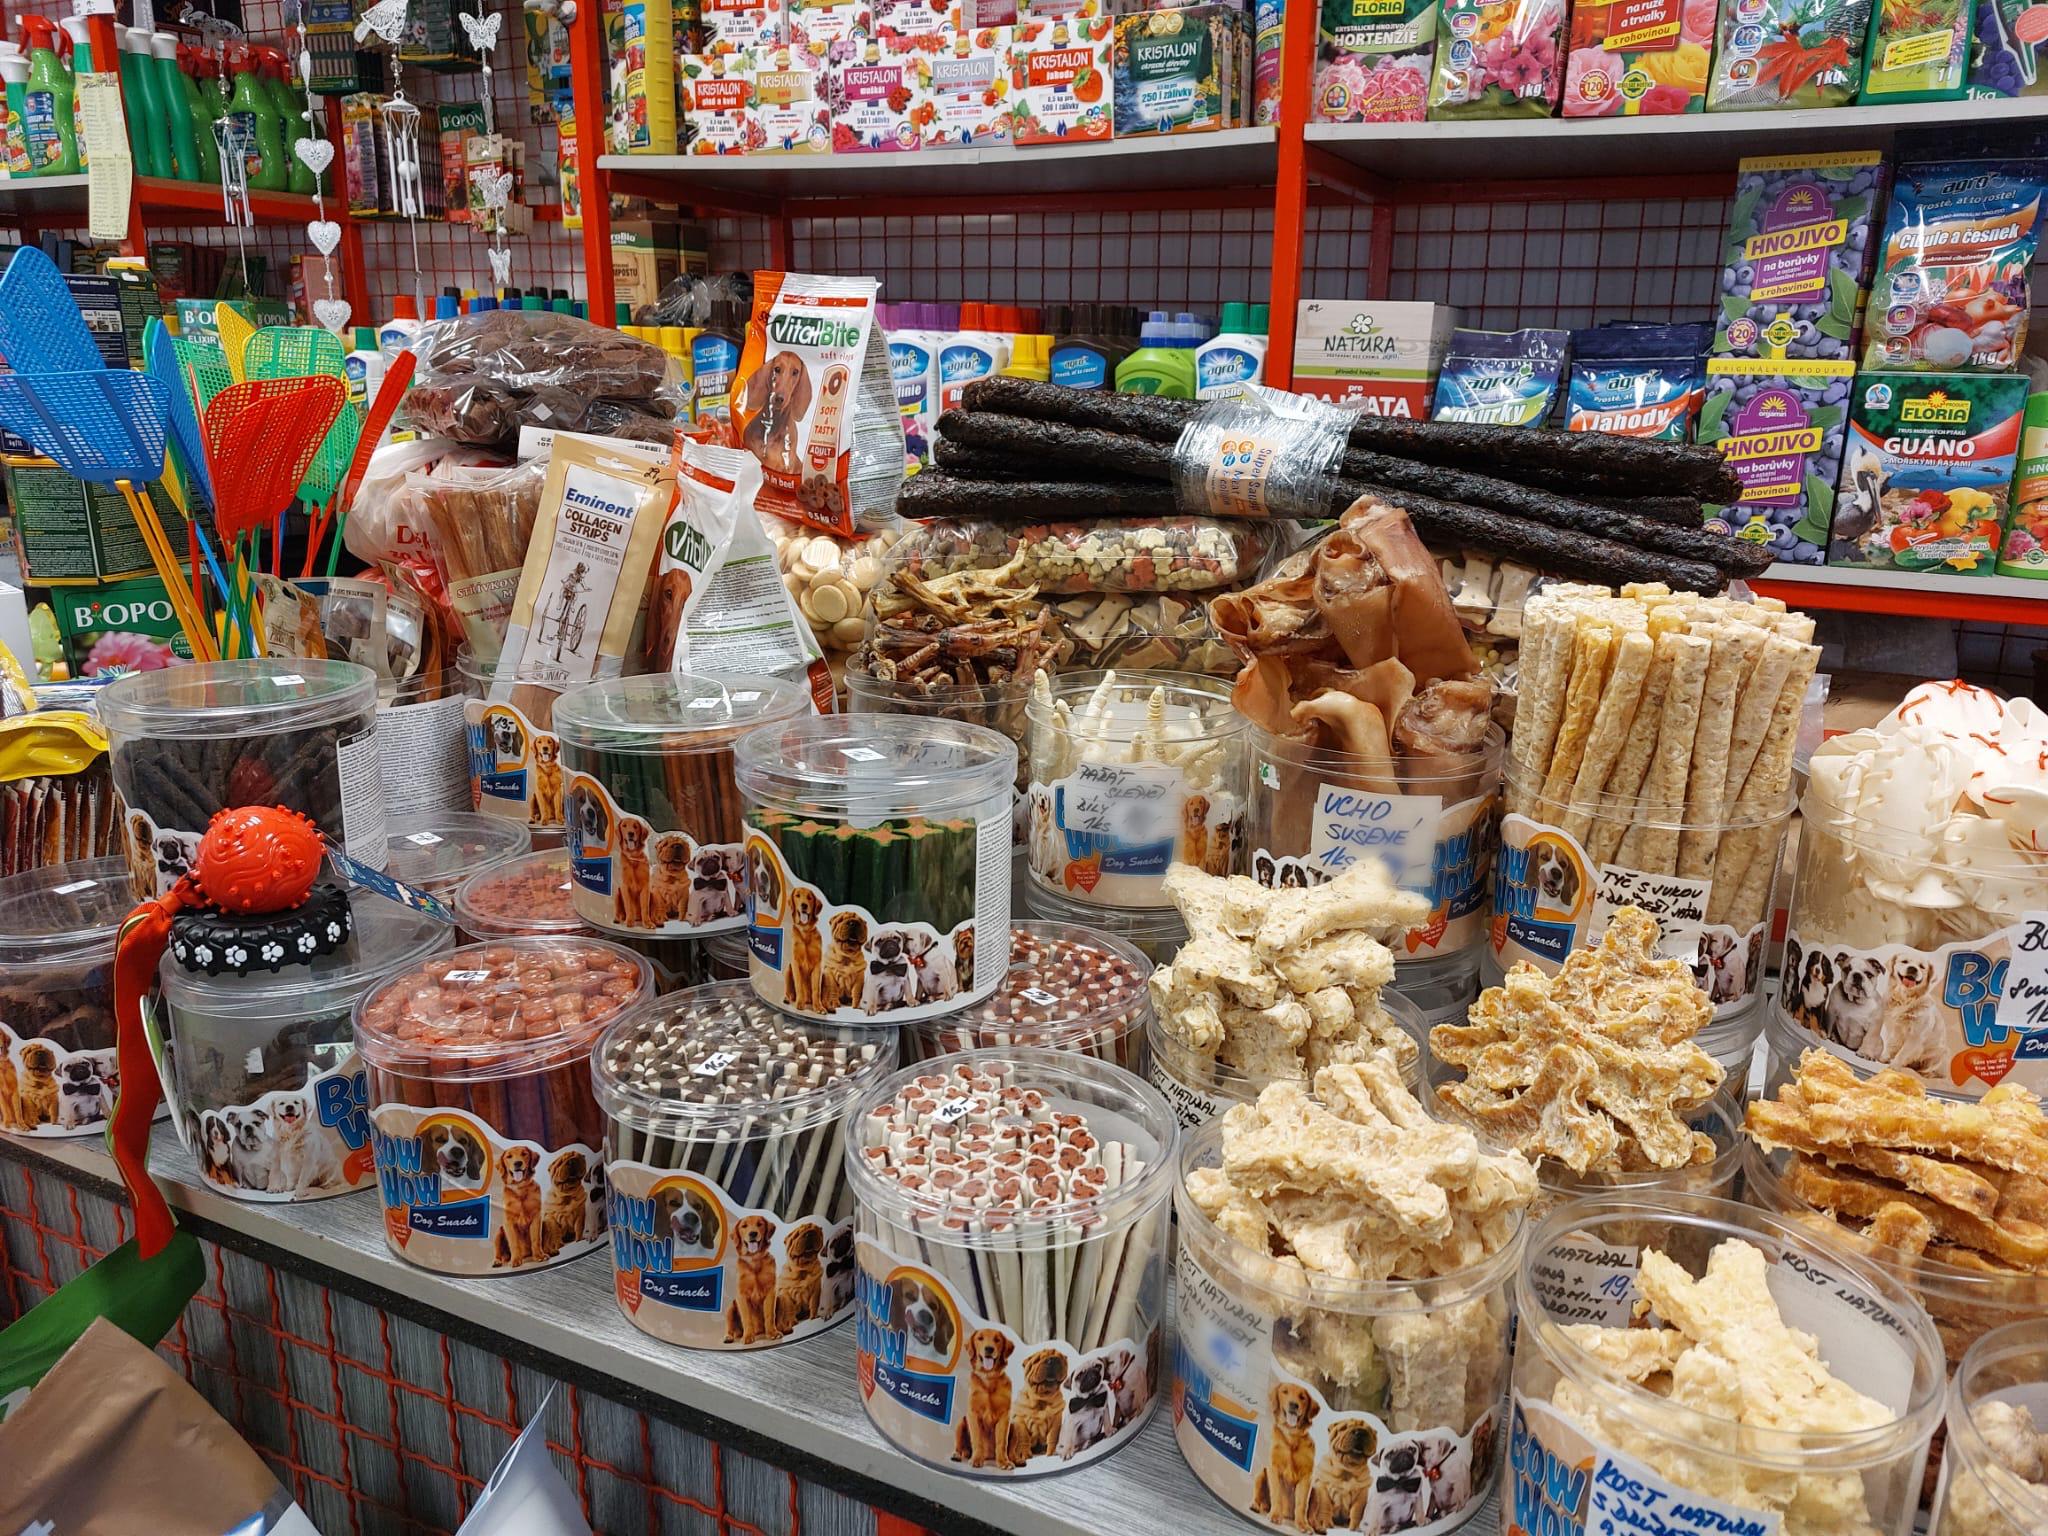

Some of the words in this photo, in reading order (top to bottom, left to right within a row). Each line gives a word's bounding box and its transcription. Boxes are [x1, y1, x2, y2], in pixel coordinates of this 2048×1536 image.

[1354, 1, 1403, 15] FLORIA
[1626, 2, 1640, 13] na
[1620, 18, 1628, 28] a
[1630, 10, 1668, 26] trvalky
[1334, 31, 1418, 47] HORTENZIE
[1613, 38, 1618, 46] s
[1620, 26, 1671, 45] rohovinou
[1137, 42, 1197, 62] KRISTALON
[1032, 52, 1090, 71] KRISTALON
[847, 70, 898, 85] KRISTALON
[936, 62, 989, 80] KRISTALON
[697, 82, 740, 96] KRISTALON
[760, 74, 808, 88] KRISTALON
[1586, 81, 1602, 92] 120
[1142, 92, 1158, 103] 250
[1164, 88, 1192, 100] zálivky
[1818, 156, 1872, 165] PRODUKT
[1942, 176, 1989, 196] agro
[1984, 190, 2016, 203] roste!
[1750, 224, 1841, 257] HNOJIVO
[1951, 232, 1958, 244] a
[1962, 223, 2020, 244] česnek
[1763, 262, 1776, 272] na
[1776, 253, 1820, 271] borůvky
[1764, 281, 1816, 296] rohovinou
[188, 335, 218, 345] ELIXIR
[1735, 328, 1750, 340] 20
[1324, 336, 1396, 353] NATURA
[947, 360, 972, 372] agro
[1208, 363, 1234, 376] agro
[1715, 365, 1784, 374] ORIGINÁLNÍ
[1792, 363, 1846, 375] PRODUKT
[1348, 385, 1364, 393] pro
[820, 406, 836, 416] SOFT
[1904, 408, 1968, 421] FLORIA
[814, 424, 836, 436] TASTY
[810, 446, 832, 457] ADULT
[1724, 432, 1816, 457] HNOJIVO
[1884, 434, 1976, 458] GUÁNO
[1250, 448, 1273, 480] Super
[1736, 465, 1750, 475] na
[1752, 459, 1795, 473] borůvky
[1888, 456, 1936, 466] MOŘSKÝMI
[1936, 457, 1972, 468] ŘASAMI
[778, 476, 794, 490] beef
[566, 487, 634, 519] Eminent
[564, 508, 623, 535] COLLAGEN
[570, 522, 610, 542] STRIPS
[482, 780, 494, 791] Dog
[494, 781, 520, 792] Snacks
[1104, 856, 1125, 870] Dog
[1128, 856, 1164, 867] Snacks
[582, 868, 604, 882] Snacks
[1603, 870, 1639, 888] TYČ
[1638, 882, 1650, 893] S
[1452, 900, 1467, 913] Dog
[1510, 922, 1525, 940] Dog
[1526, 931, 1563, 950] Snacks
[2026, 1038, 2048, 1052] Dog
[1168, 1083, 1217, 1117] NATURAL
[942, 1100, 970, 1118] 16,-
[380, 1172, 442, 1209] WOW
[414, 1212, 432, 1228] Dog
[438, 1214, 478, 1228] Snacks
[614, 1229, 674, 1273] WOW
[1548, 1245, 1634, 1268] NATURAL
[1782, 1250, 1838, 1286] KOST
[644, 1278, 664, 1296] Dog
[669, 1283, 711, 1298] Snacks
[1199, 1277, 1268, 1336] NATURAL
[878, 1366, 896, 1392] Dog
[898, 1382, 942, 1408] Snacks
[1186, 1396, 1202, 1425] Dog
[1203, 1416, 1243, 1452] Snacks
[1511, 1417, 1588, 1516] BOW
[1595, 1458, 1668, 1508] KOST
